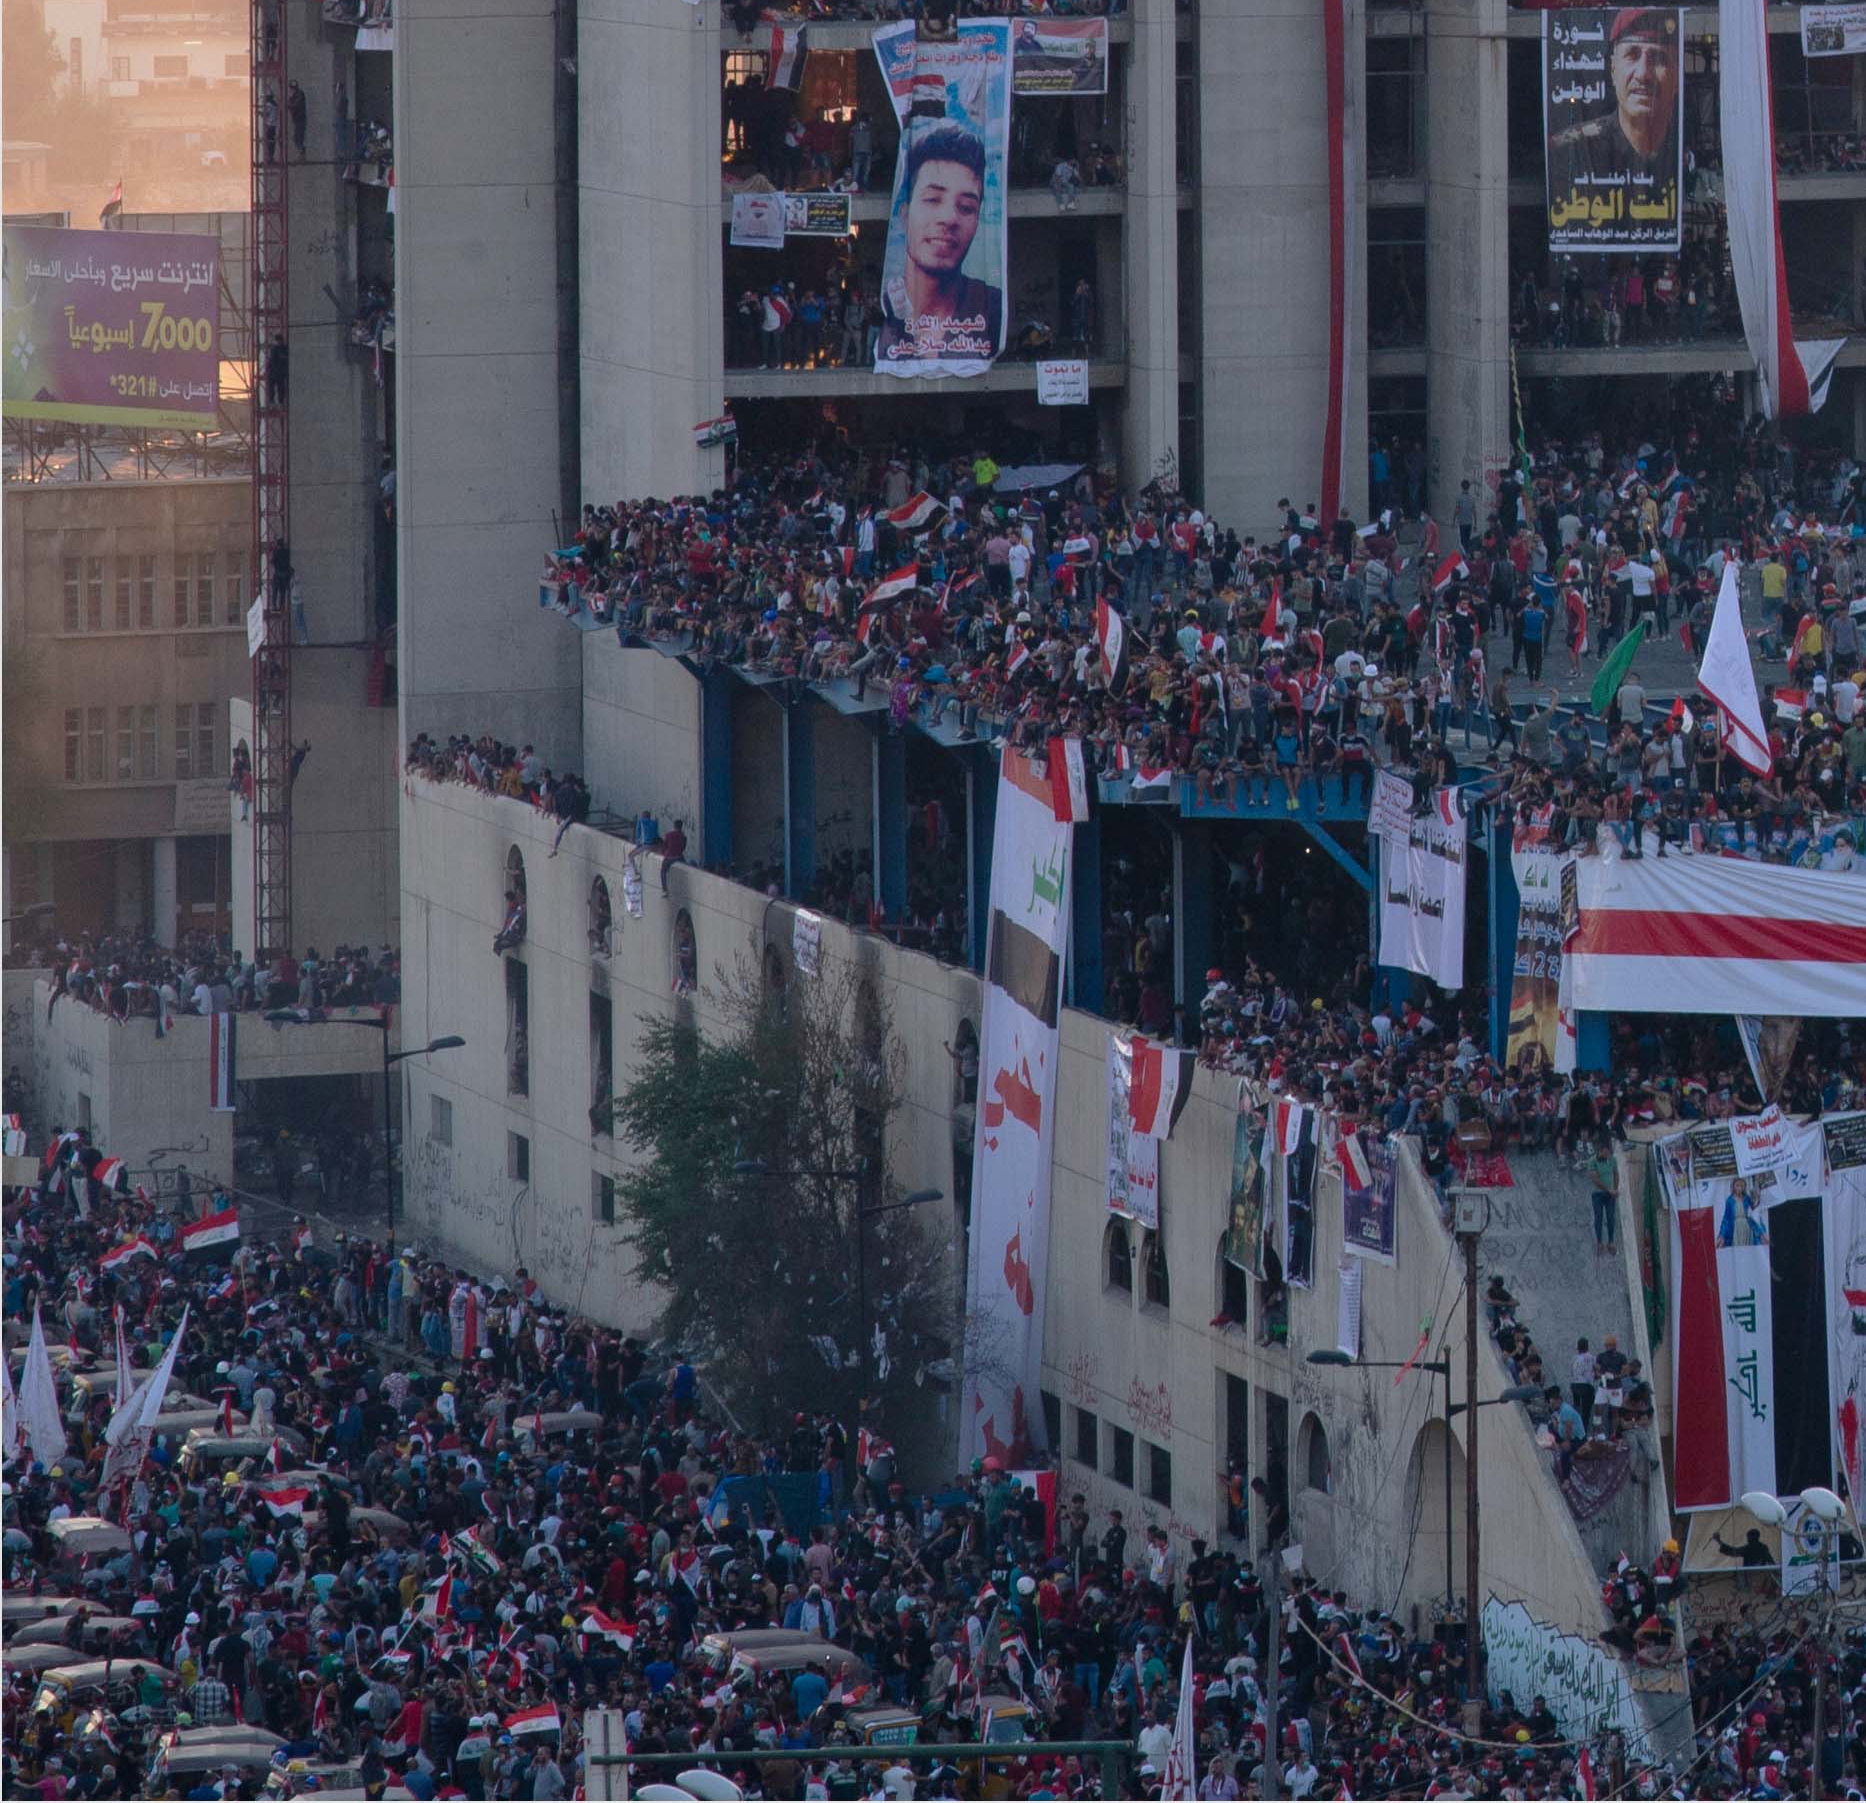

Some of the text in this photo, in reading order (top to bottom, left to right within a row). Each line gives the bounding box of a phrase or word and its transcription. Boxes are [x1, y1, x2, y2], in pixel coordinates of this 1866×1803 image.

[1553, 20, 1605, 46] ثورة
[1552, 50, 1605, 71] شهداء
[1551, 79, 1606, 104] الوطن
[1550, 175, 1677, 228] أنت الوطن
[63, 256, 106, 286] وبأحلى
[110, 264, 154, 292] سريع
[157, 261, 214, 294] انترنت
[947, 314, 987, 332] شهيد
[159, 382, 181, 398] على
[1722, 1288, 1769, 1424] الله اكبر
